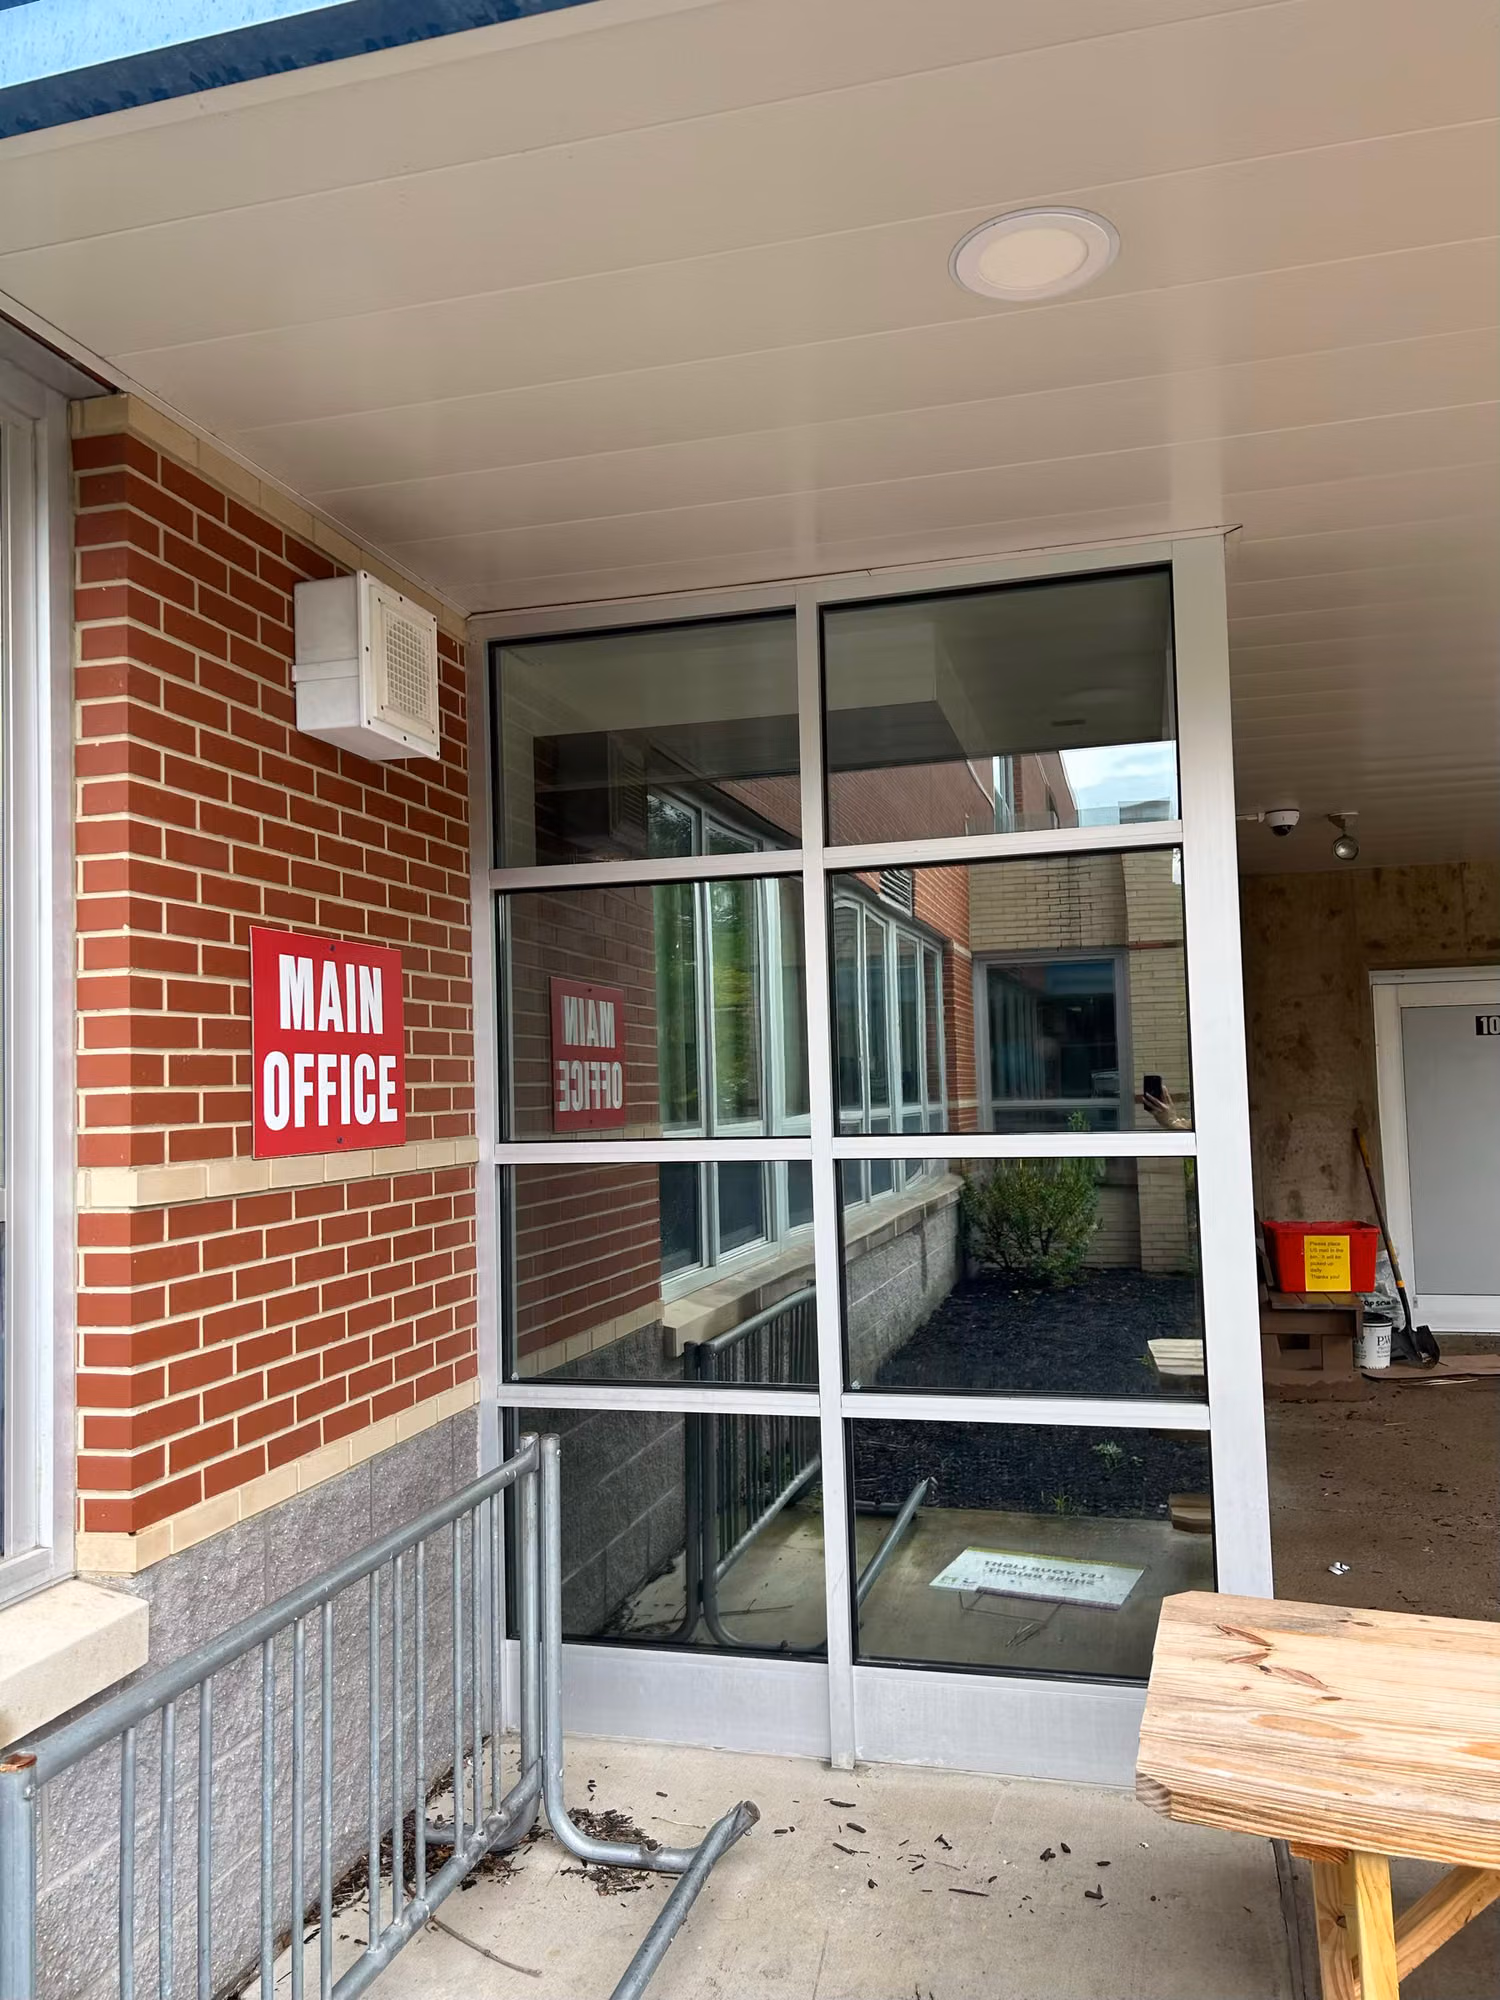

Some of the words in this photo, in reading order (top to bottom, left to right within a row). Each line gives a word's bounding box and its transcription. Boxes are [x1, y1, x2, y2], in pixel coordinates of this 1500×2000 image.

[279, 954, 384, 1035] MAIN
[1480, 1016, 1500, 1035] 10
[263, 1051, 398, 1132] OFFICE
